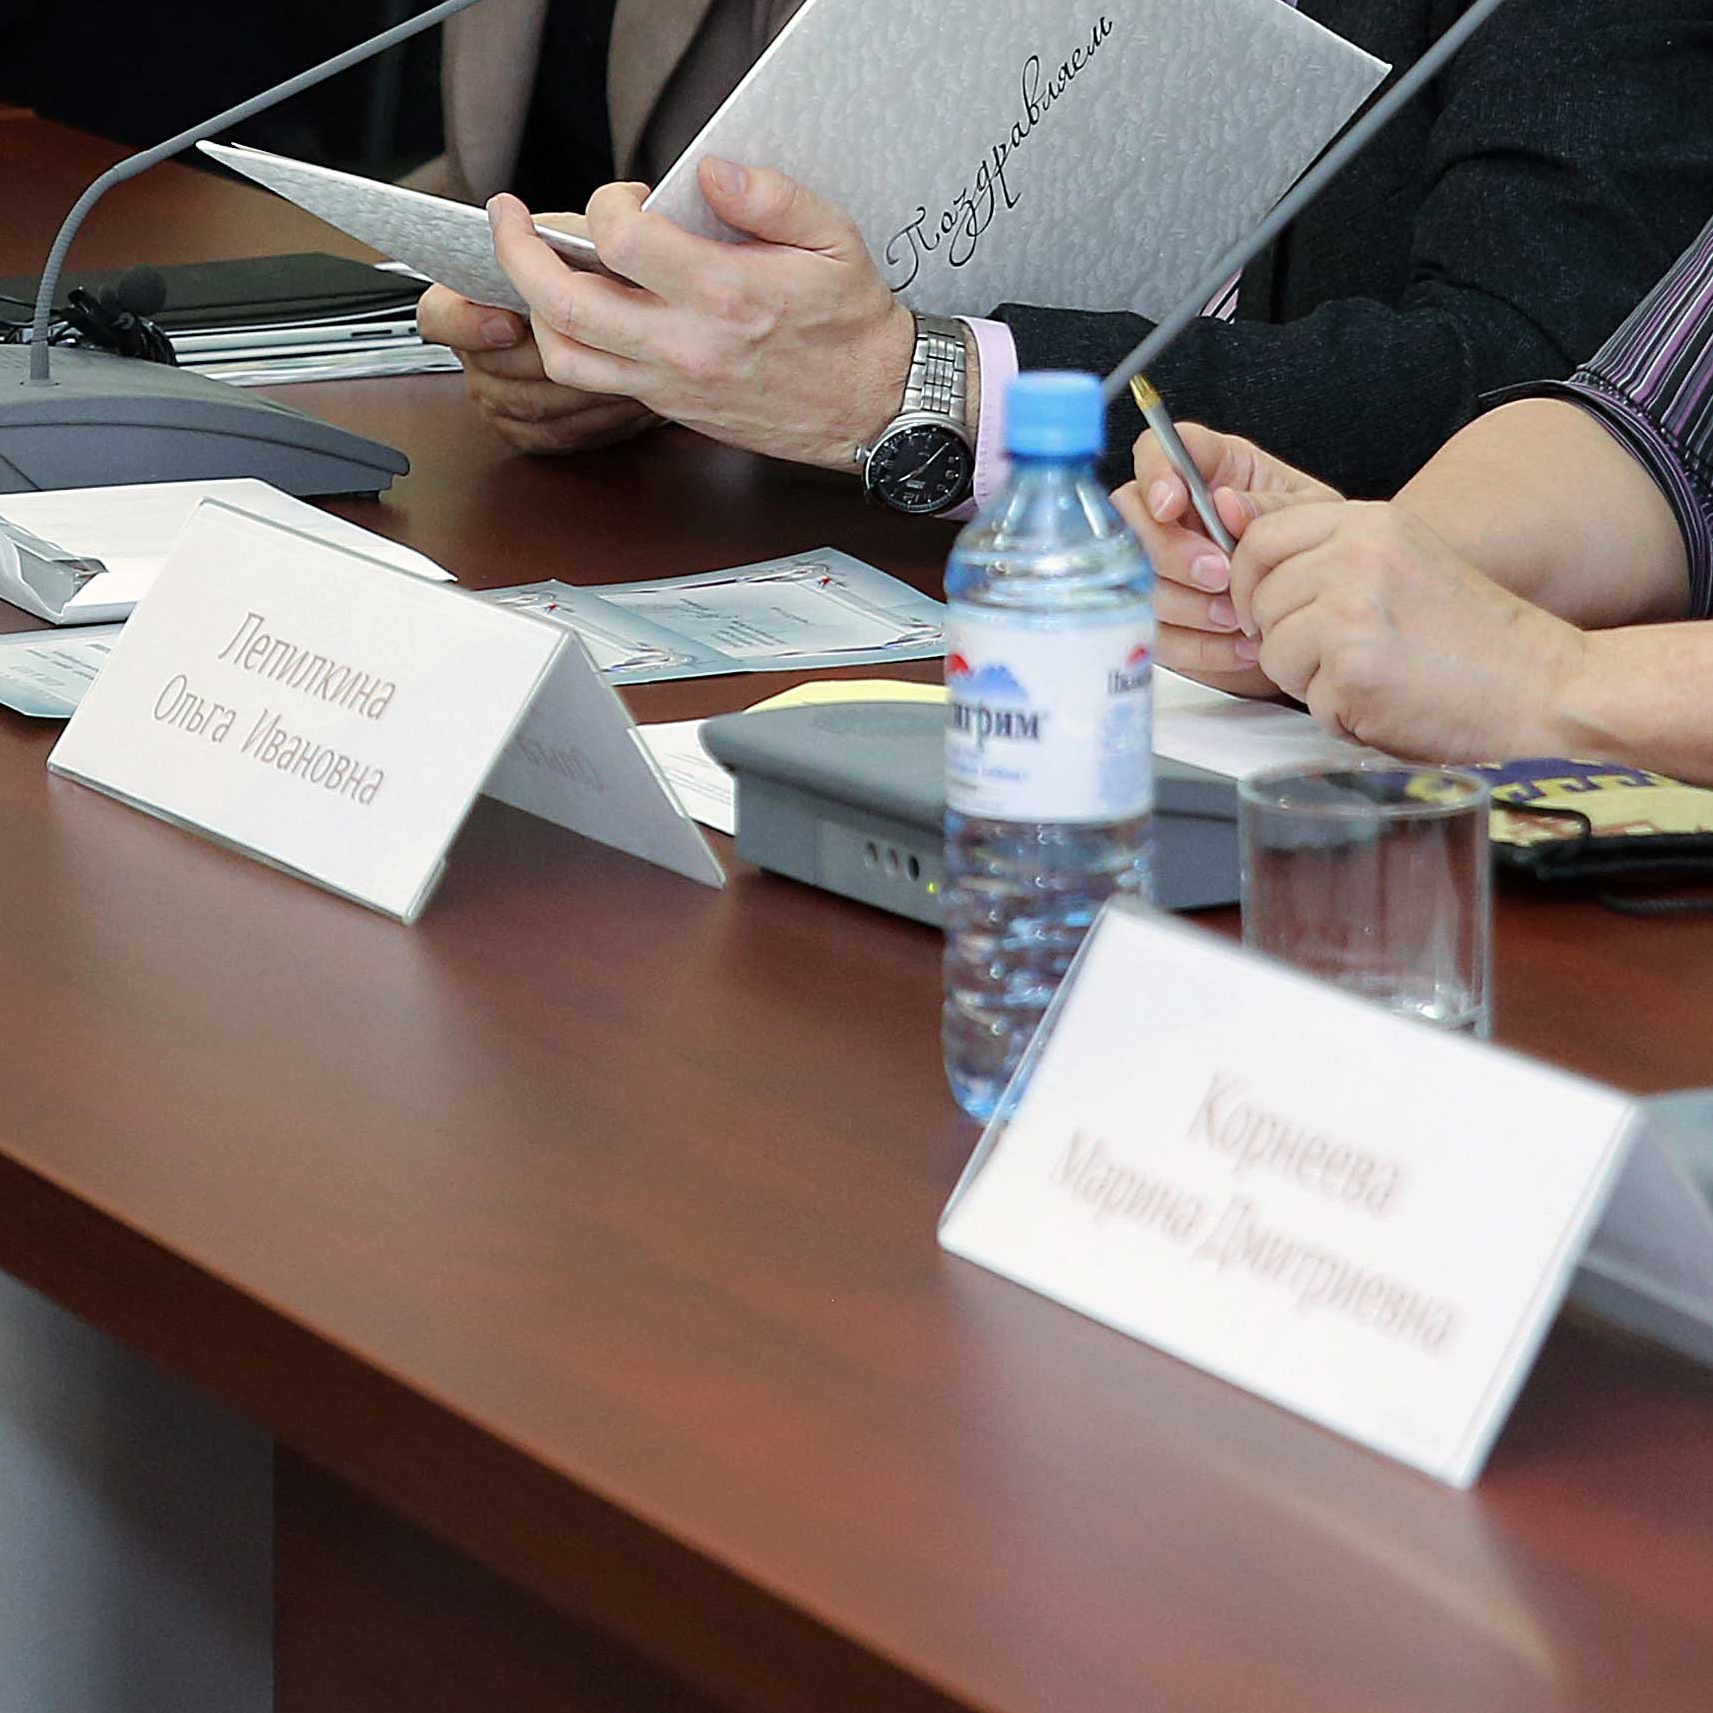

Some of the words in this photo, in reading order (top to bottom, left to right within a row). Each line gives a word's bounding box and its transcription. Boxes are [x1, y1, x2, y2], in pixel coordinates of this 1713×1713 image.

[886, 16, 1113, 293] Поздравляем
[152, 673, 237, 744] Ольга
[241, 706, 385, 806] Ивановна
[218, 612, 396, 724] Лепилкина
[1186, 1071, 1404, 1220] Корнеева
[1054, 1129, 1201, 1245] Марина
[1195, 1195, 1457, 1355] Дмитриевна
